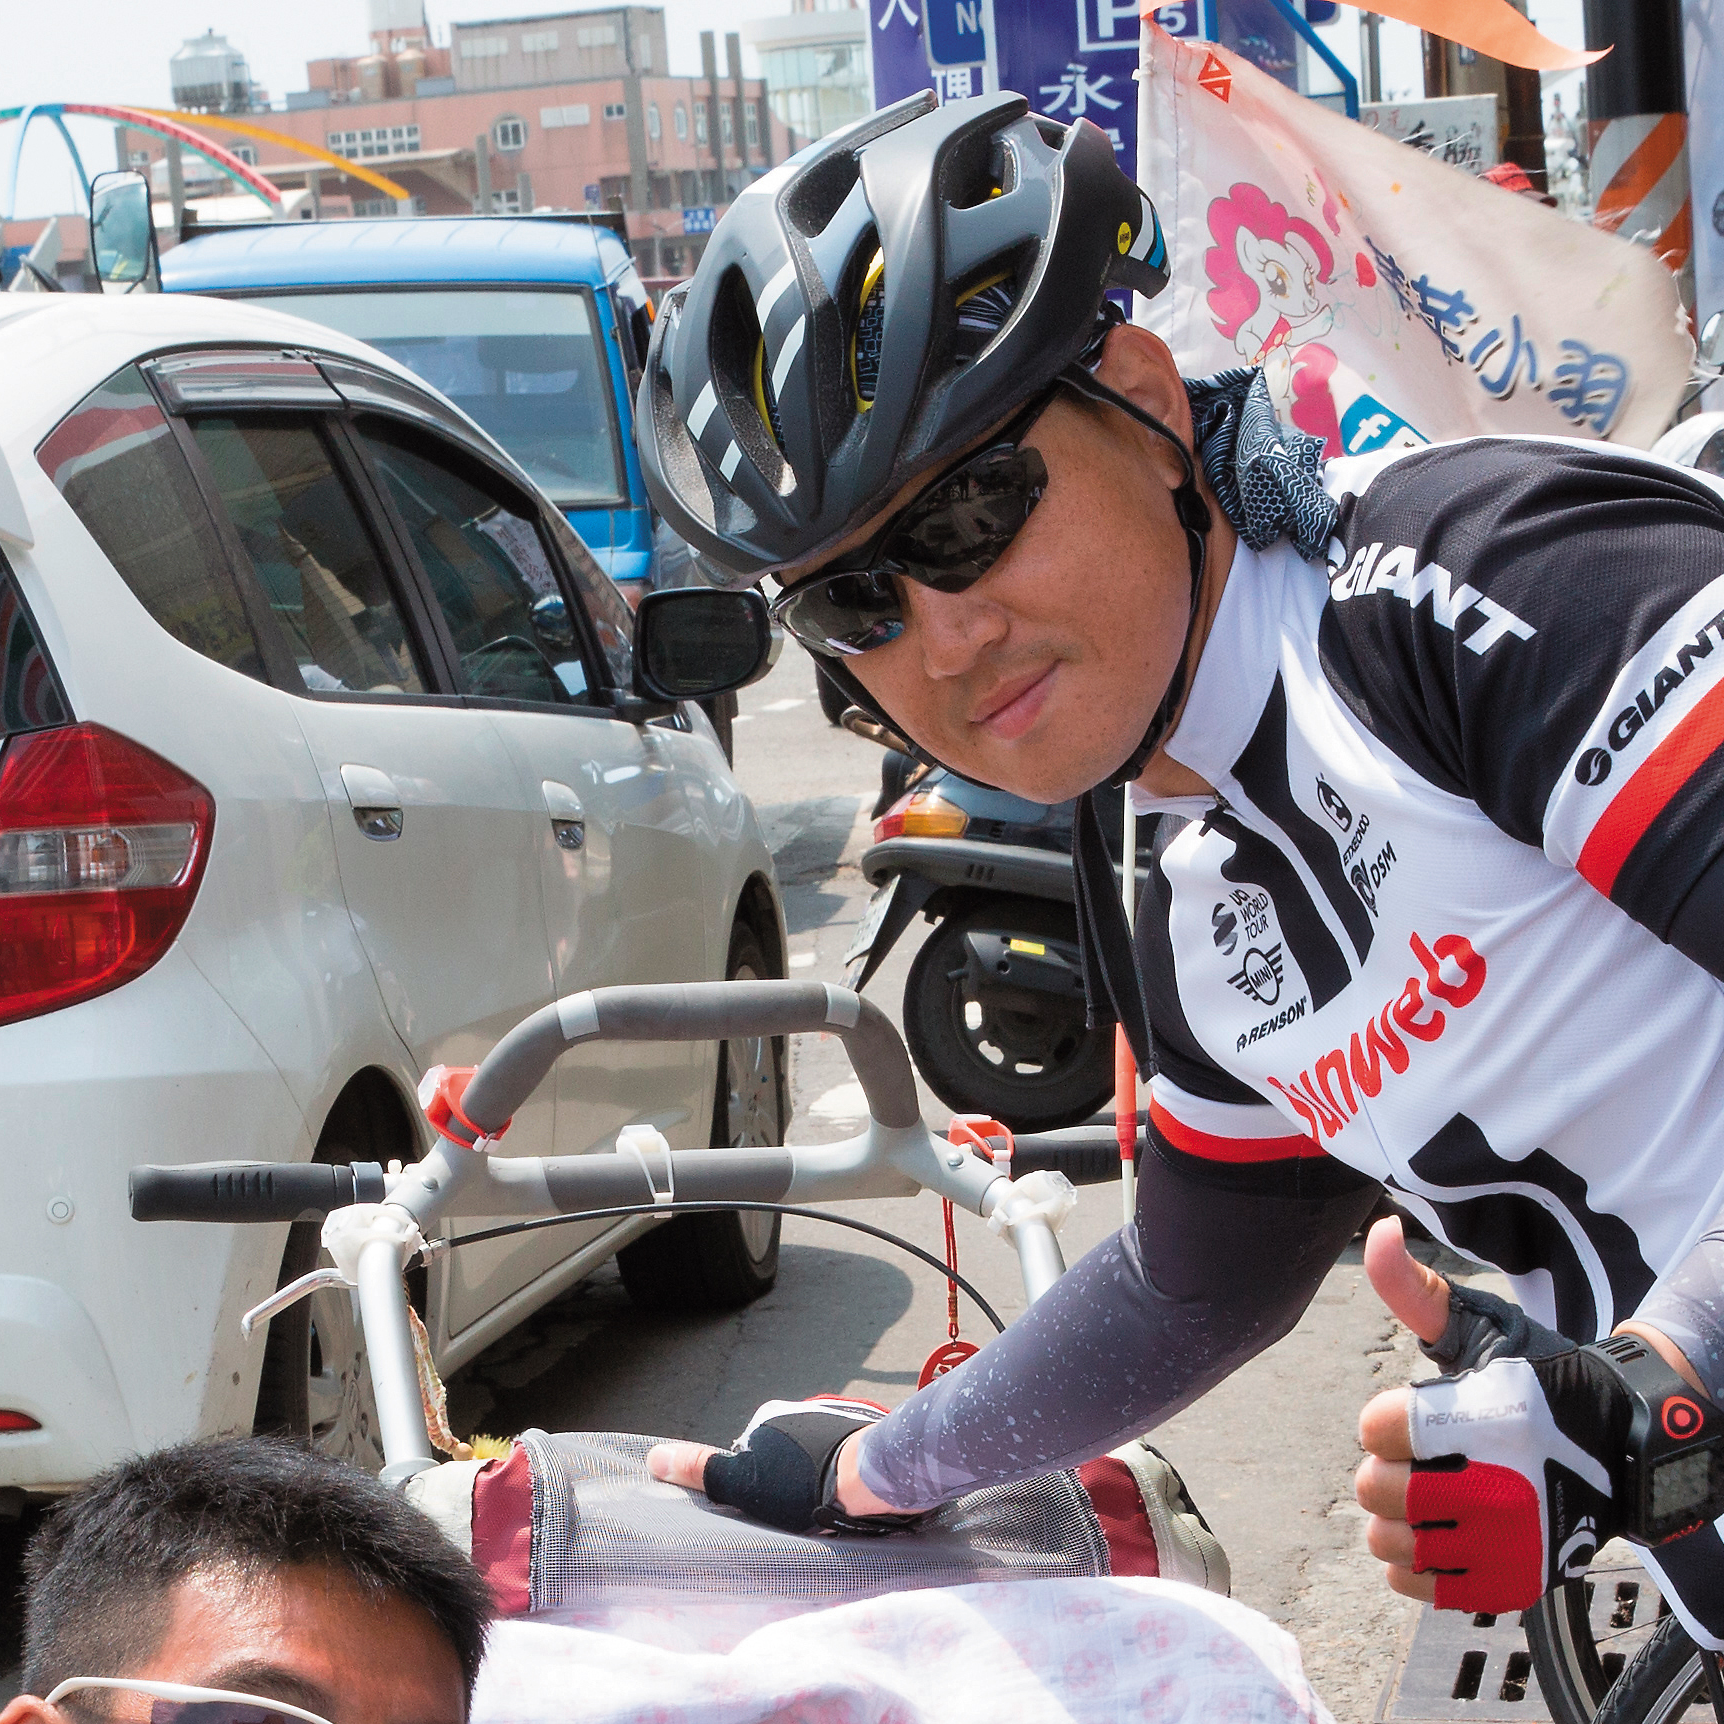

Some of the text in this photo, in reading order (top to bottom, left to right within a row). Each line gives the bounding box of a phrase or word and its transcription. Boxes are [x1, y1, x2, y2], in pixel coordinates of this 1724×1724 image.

[1330, 542, 1537, 656] GIANT
[1370, 840, 1397, 889] DSM
[1240, 892, 1269, 923] WORLD
[1244, 914, 1269, 942] TOUR
[1250, 965, 1273, 990] MINI
[1248, 998, 1306, 1045] RENSON
[1426, 1410, 1475, 1427] PEARL
